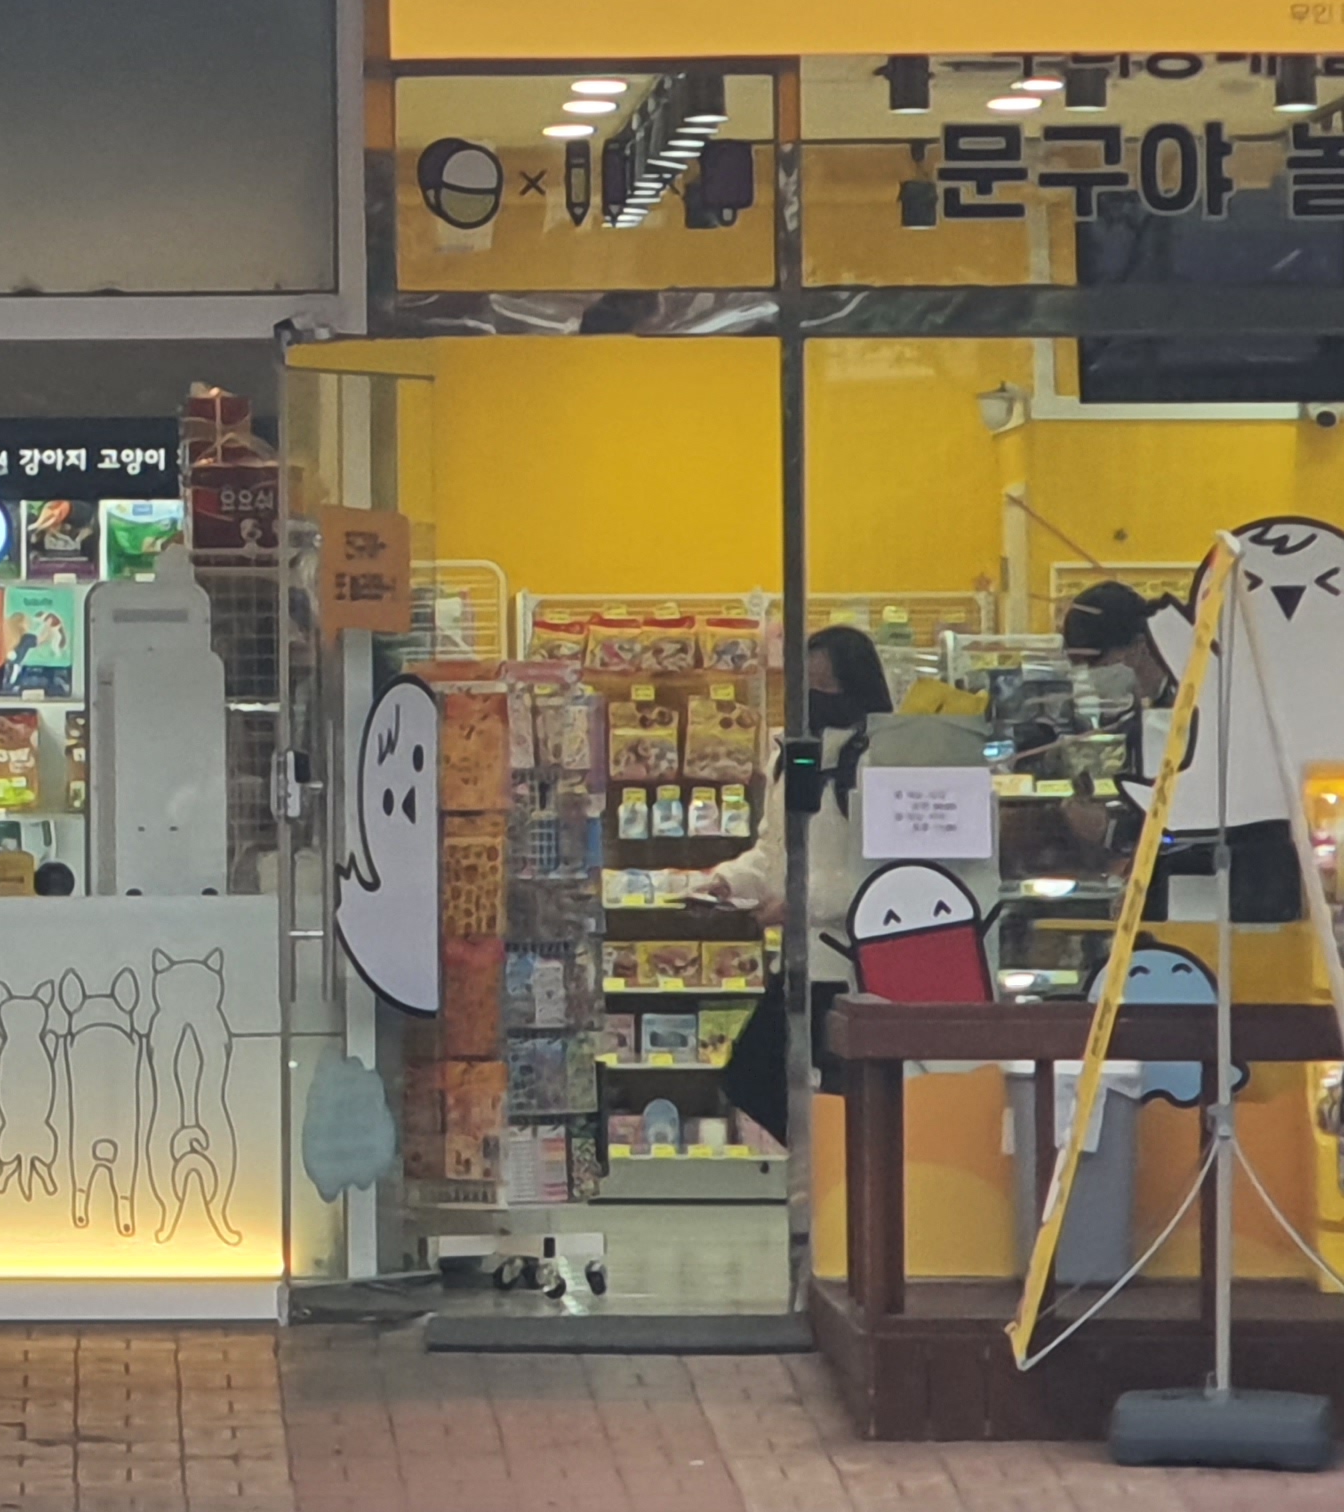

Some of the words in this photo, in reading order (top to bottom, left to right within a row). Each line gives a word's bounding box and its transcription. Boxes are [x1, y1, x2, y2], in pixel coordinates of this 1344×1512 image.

[936, 120, 1235, 220] 문구야
[18, 447, 87, 476] 강아지
[96, 447, 166, 476] 고양이
